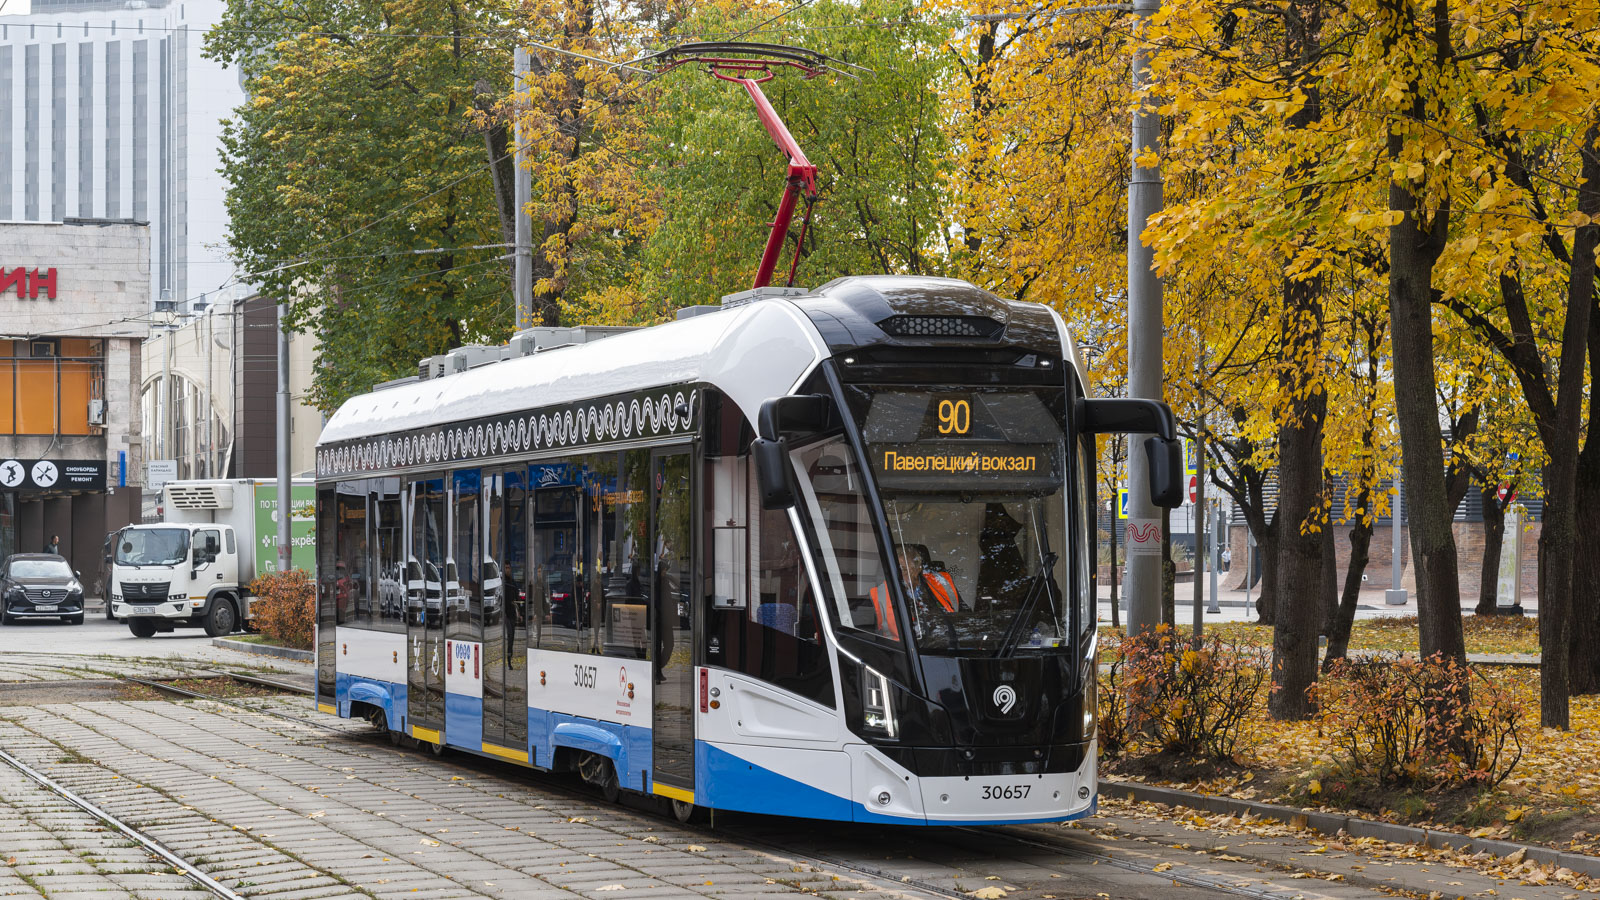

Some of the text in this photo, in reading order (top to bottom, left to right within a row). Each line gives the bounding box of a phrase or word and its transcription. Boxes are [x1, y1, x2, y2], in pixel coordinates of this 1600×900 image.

[0, 266, 57, 299] ИН
[938, 399, 970, 434] 90
[884, 451, 1036, 473] Павелецкий вокзал
[260, 500, 270, 509] ПО
[574, 664, 597, 689] 30657
[981, 785, 1031, 800] 30657
